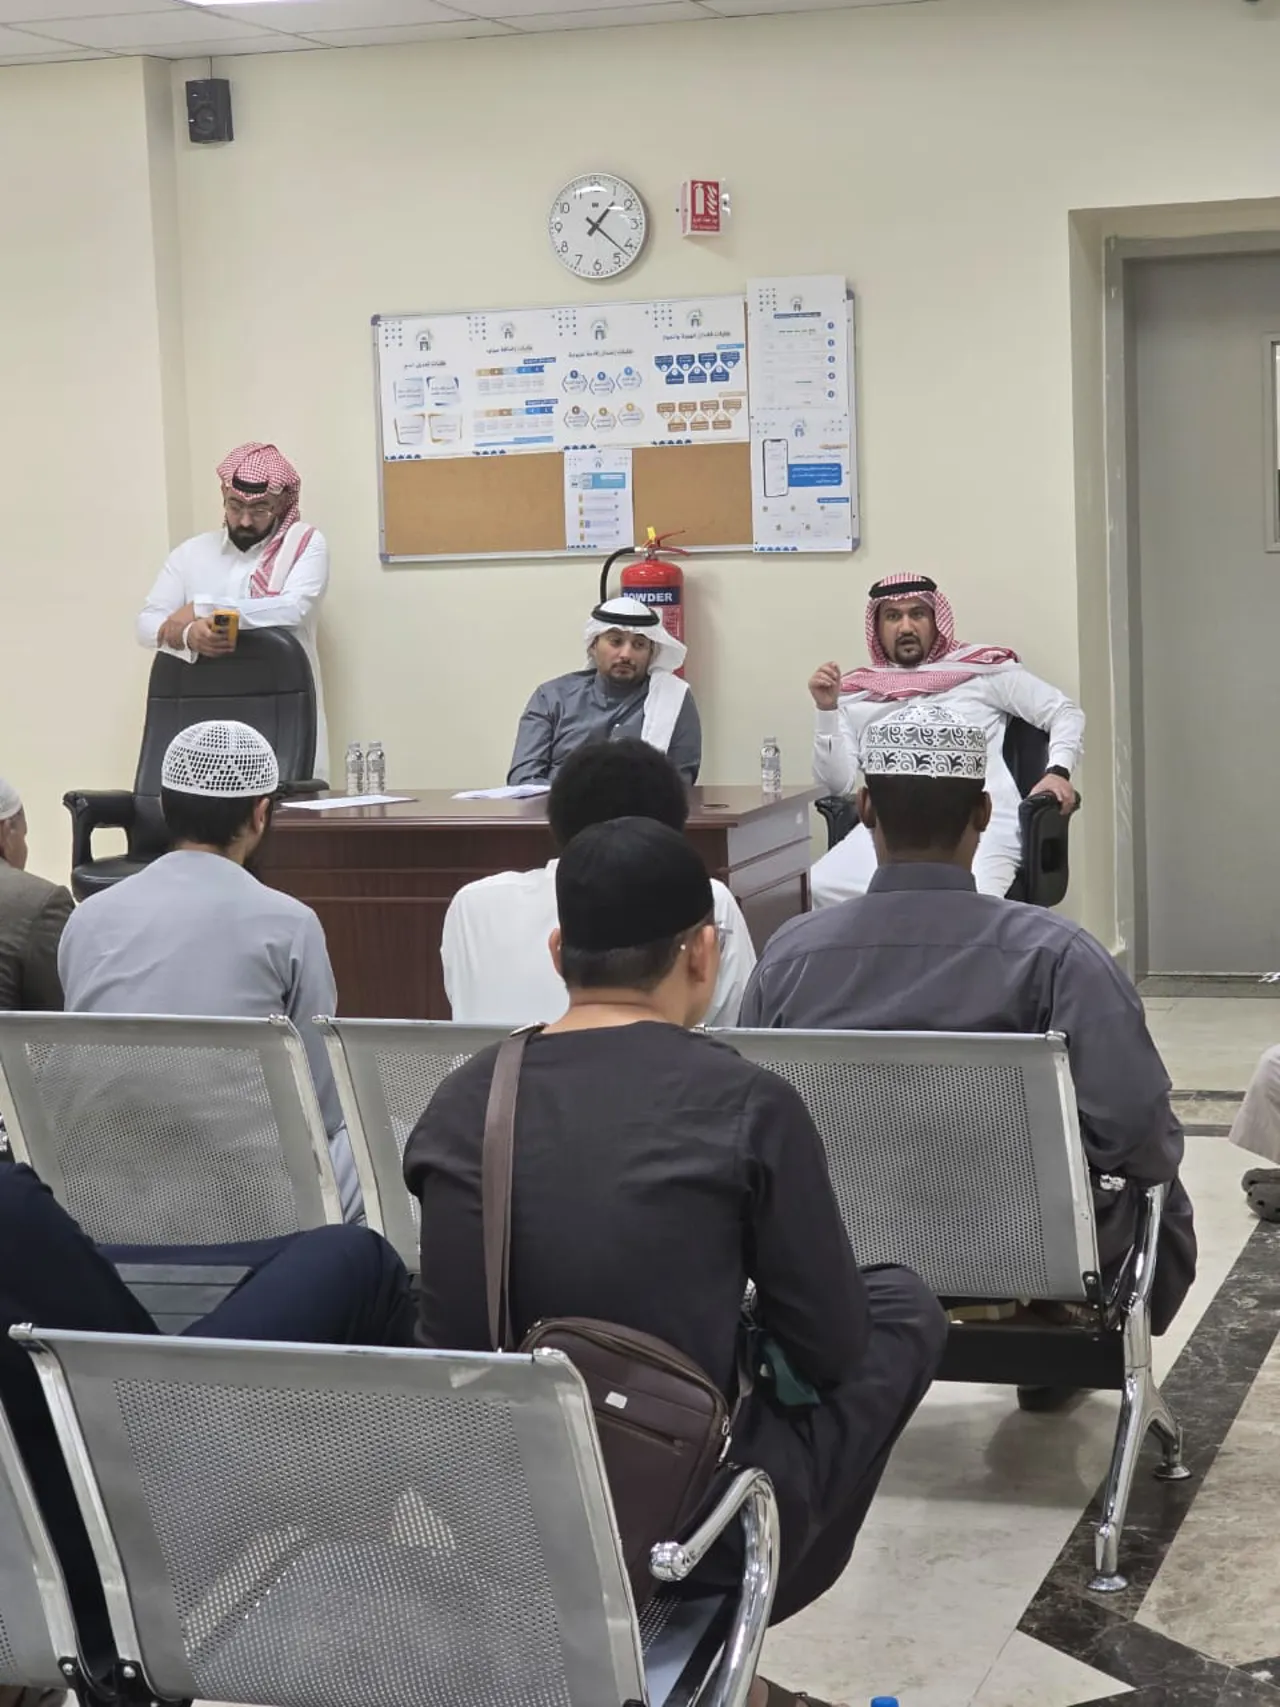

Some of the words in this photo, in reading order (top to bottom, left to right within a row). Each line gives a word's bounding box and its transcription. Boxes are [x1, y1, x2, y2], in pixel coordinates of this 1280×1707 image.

[560, 202, 570, 214] 10
[624, 198, 633, 211] 2
[554, 221, 563, 233] 9
[630, 218, 640, 230] 3
[560, 240, 569, 253] 8
[624, 238, 634, 249] 4
[575, 254, 583, 266] 7
[613, 252, 621, 265] 5
[593, 259, 602, 272] 6
